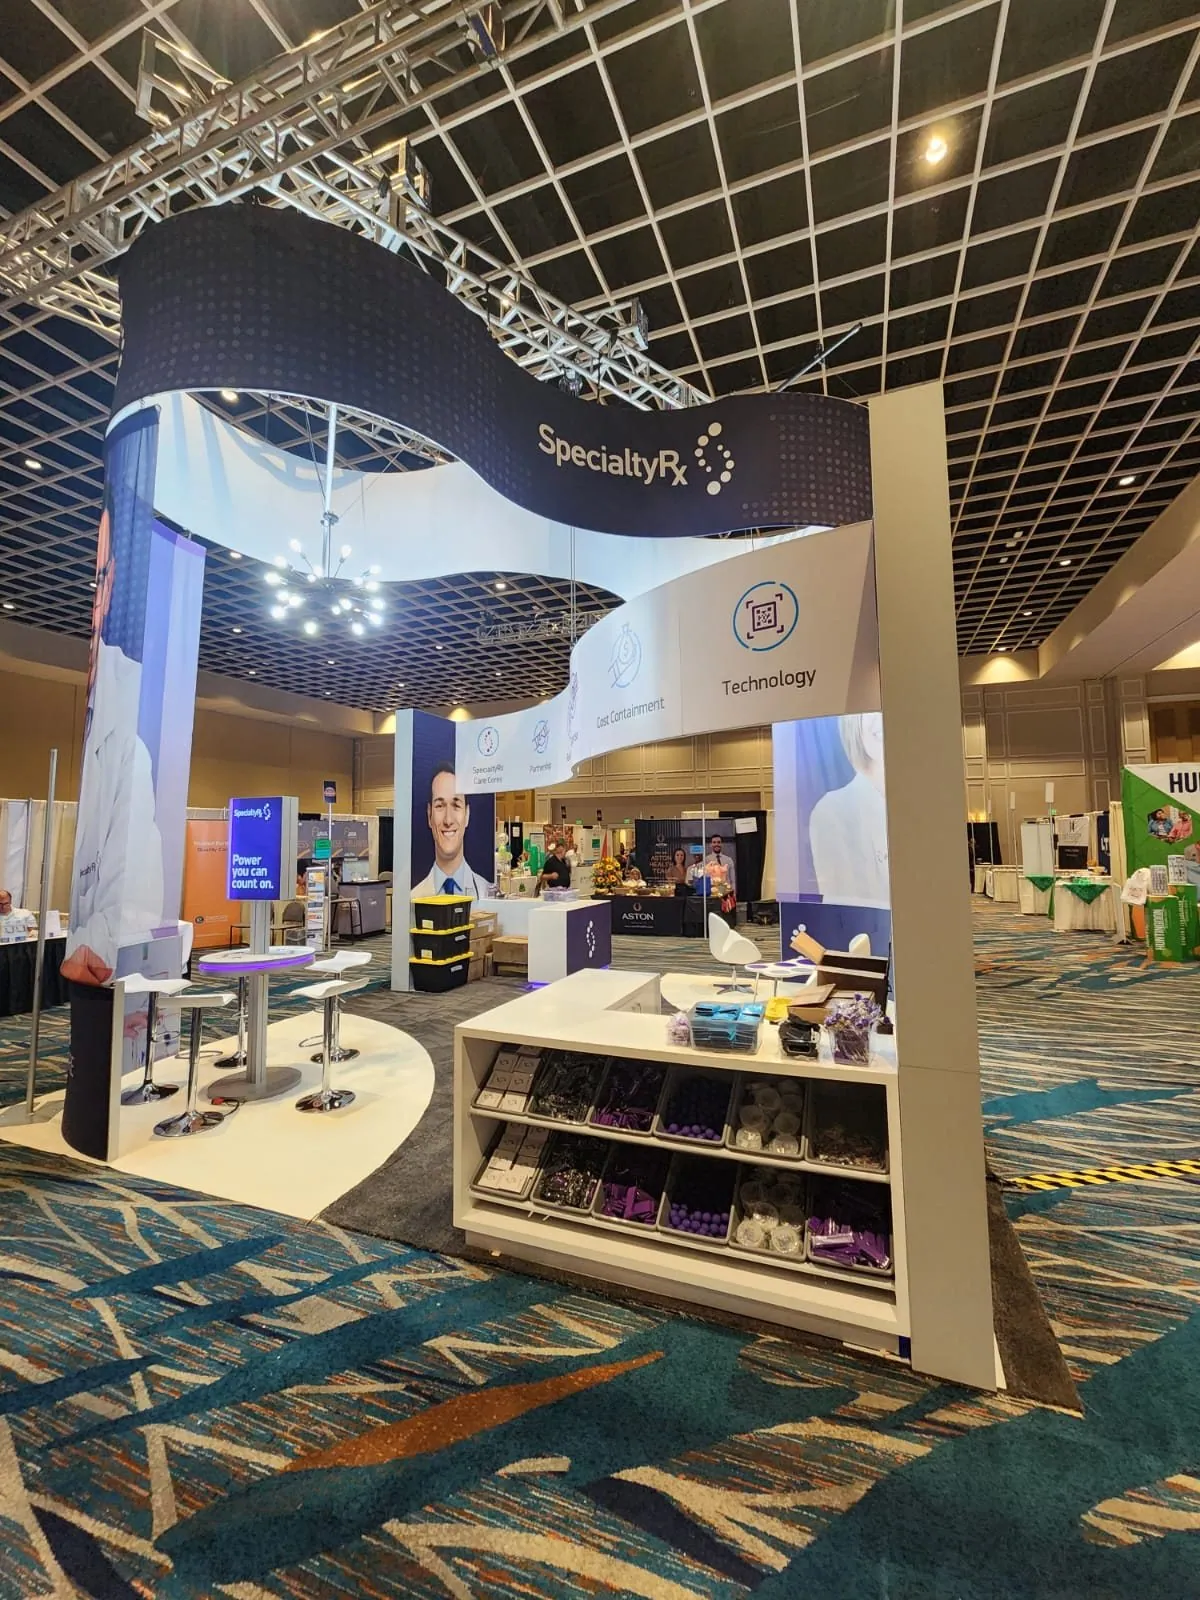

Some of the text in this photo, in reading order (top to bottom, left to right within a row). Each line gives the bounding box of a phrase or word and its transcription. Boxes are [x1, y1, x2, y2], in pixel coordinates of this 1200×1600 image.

[538, 423, 688, 486] SpecialtyRx
[722, 668, 817, 696] Technology
[597, 697, 665, 729] Cost Containment
[1169, 772, 1200, 793] HU
[232, 854, 262, 866] Power
[232, 867, 267, 877] you can
[232, 878, 274, 889] count on.
[622, 913, 654, 921] ASTON
